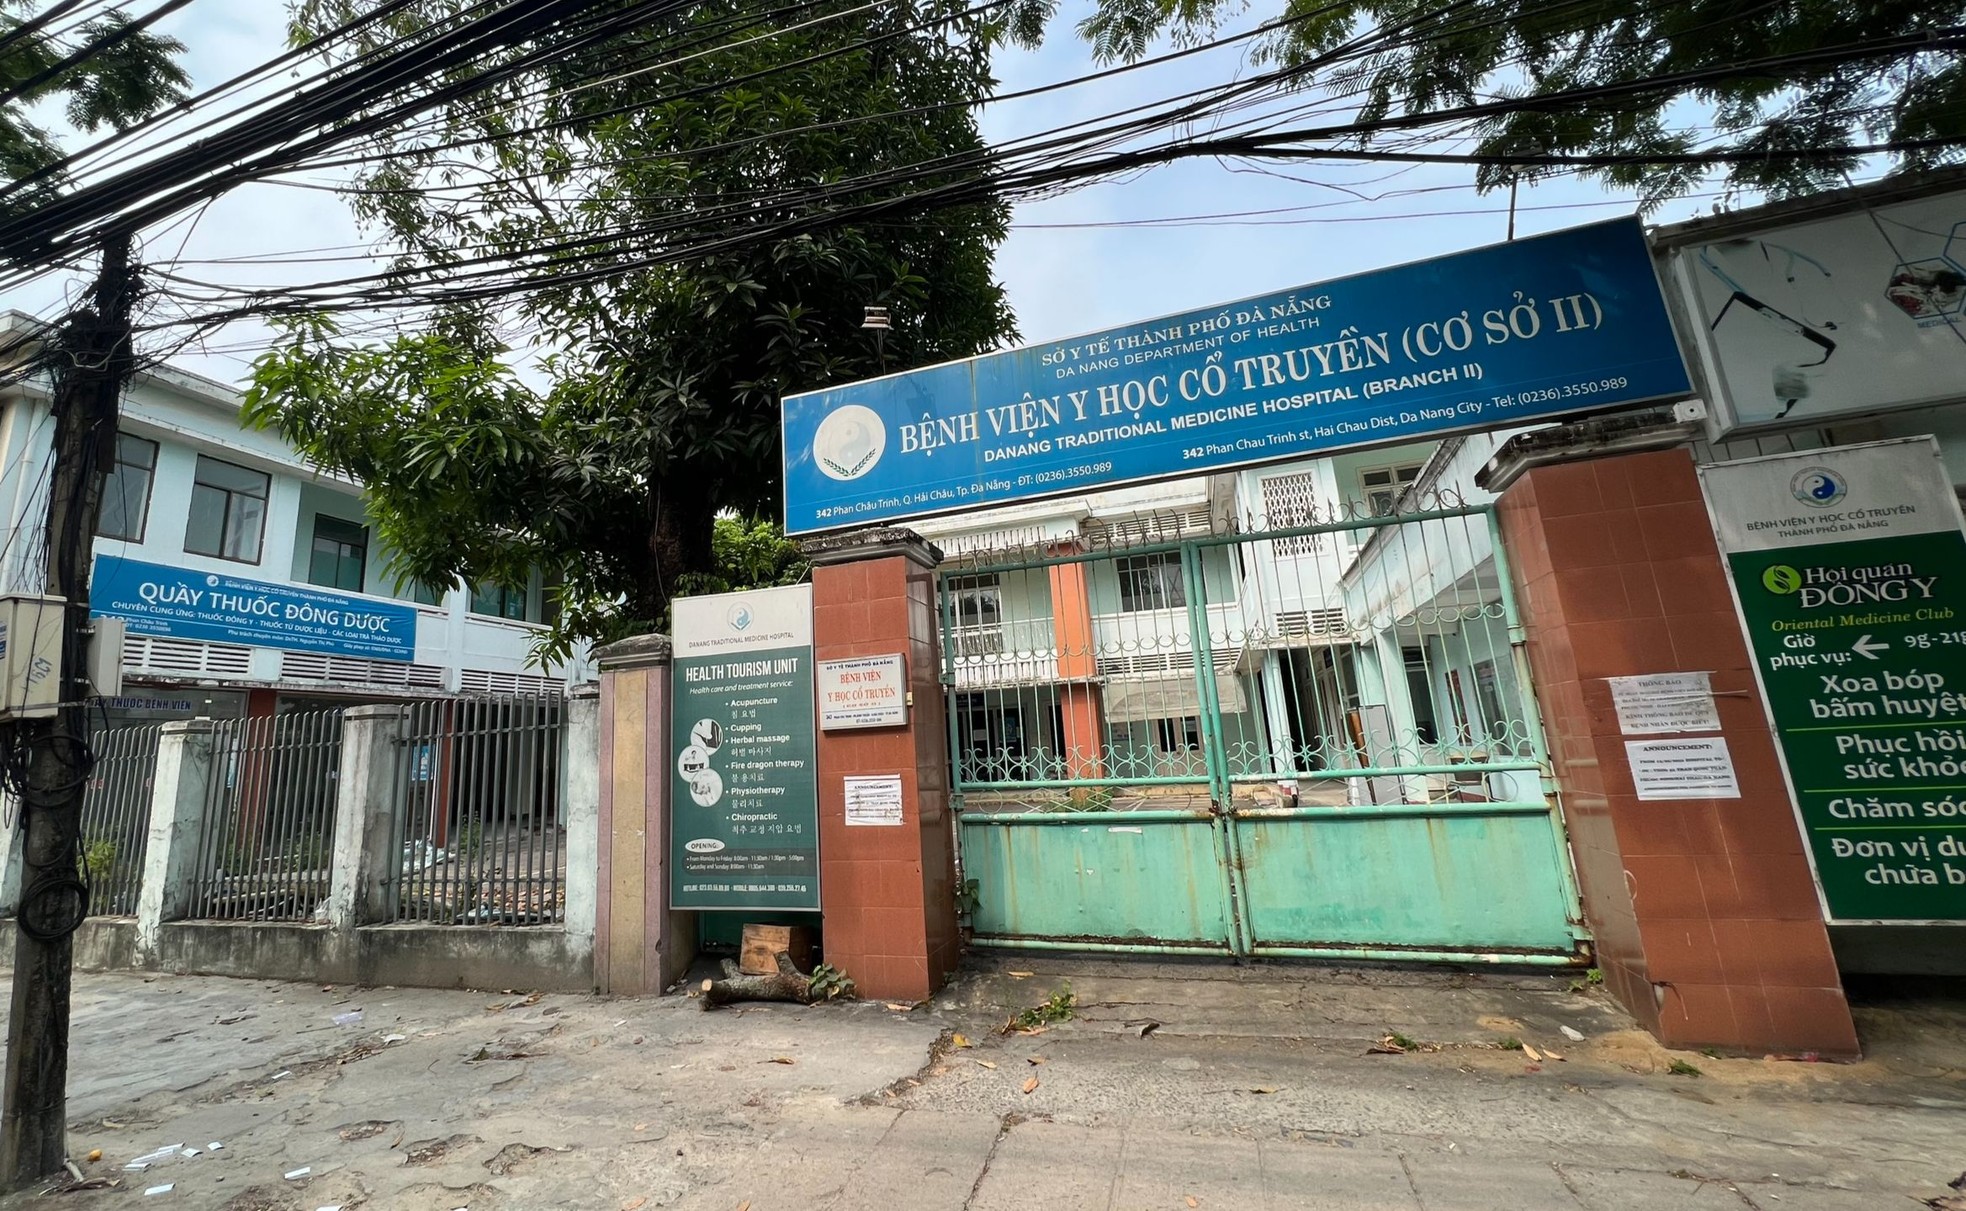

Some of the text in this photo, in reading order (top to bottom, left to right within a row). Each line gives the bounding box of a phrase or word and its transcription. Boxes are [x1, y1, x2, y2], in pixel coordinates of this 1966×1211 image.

[1042, 295, 1331, 367] SỞ Y TẾ THÀNH PHỐ ĐÀ NẴNG
[1056, 317, 1320, 379] DA NANG DEPARTMENT OF HEALTH
[900, 290, 1603, 457] BỆNH VIỆN Y HỌC CỔ TRUYỀN (CƠ SỞ II)
[984, 362, 1483, 463] DANANG TRADITIONAL MEDICINE HOSPITAL (BRANCH II)
[1182, 376, 1628, 460] 342 Phan Chau Trinh st, Hai Chau Dist, Da Nang City Tel: (0236).3550.989
[815, 508, 832, 519] 342
[833, 502, 854, 517] Phan
[855, 499, 877, 513] Châu
[903, 494, 913, 507] Q.
[914, 490, 930, 504] Hải
[930, 487, 955, 502] Châu,
[956, 485, 970, 500] Tp.
[1017, 473, 1034, 487] ĐT:
[1035, 461, 1112, 485] (0236).3550.989
[1747, 519, 1778, 531] BỆNH
[1808, 516, 1816, 524] Y
[1819, 512, 1844, 524] HỌC
[1777, 528, 1814, 539] THÀNH
[1804, 563, 1912, 584] Hội quán
[112, 601, 147, 612] CHUYÊN
[149, 605, 174, 616] CUNG
[198, 611, 224, 621] THUỐC
[225, 615, 247, 625] ĐÔNG
[260, 620, 283, 630] THUỐC
[139, 581, 391, 635] QUẦY THUỐC ĐÔNG DƯỢC
[1771, 607, 1954, 631] Oriental Medicine Club
[689, 632, 794, 648] DANANG TRADITIONAL MEDICINE HOSPITAL
[1783, 633, 1816, 648] Giờ
[686, 657, 798, 682] HEALTH TOURISM UNIT
[1770, 651, 1852, 671] phục vụ:
[689, 685, 710, 695] Health
[710, 685, 724, 693] care
[724, 683, 738, 692] and
[738, 681, 769, 691] treatment
[1820, 669, 1944, 694] Xoa bóp
[730, 697, 778, 708] Acupuncture
[1810, 691, 1966, 719] bấm huyệt
[730, 723, 762, 732] Cupping
[731, 734, 790, 744] Herbal massage
[1835, 729, 1966, 757] Phục hồi
[730, 759, 804, 770] Fire dragon therapy
[1844, 758, 1895, 779] sức
[731, 786, 785, 797] Physiotherapy
[731, 812, 778, 822] Chiropractic
[1828, 797, 1915, 819] Chăm
[1831, 837, 1895, 857] Đơn
[1900, 836, 1931, 861] vị
[1865, 863, 1939, 884] chữa
